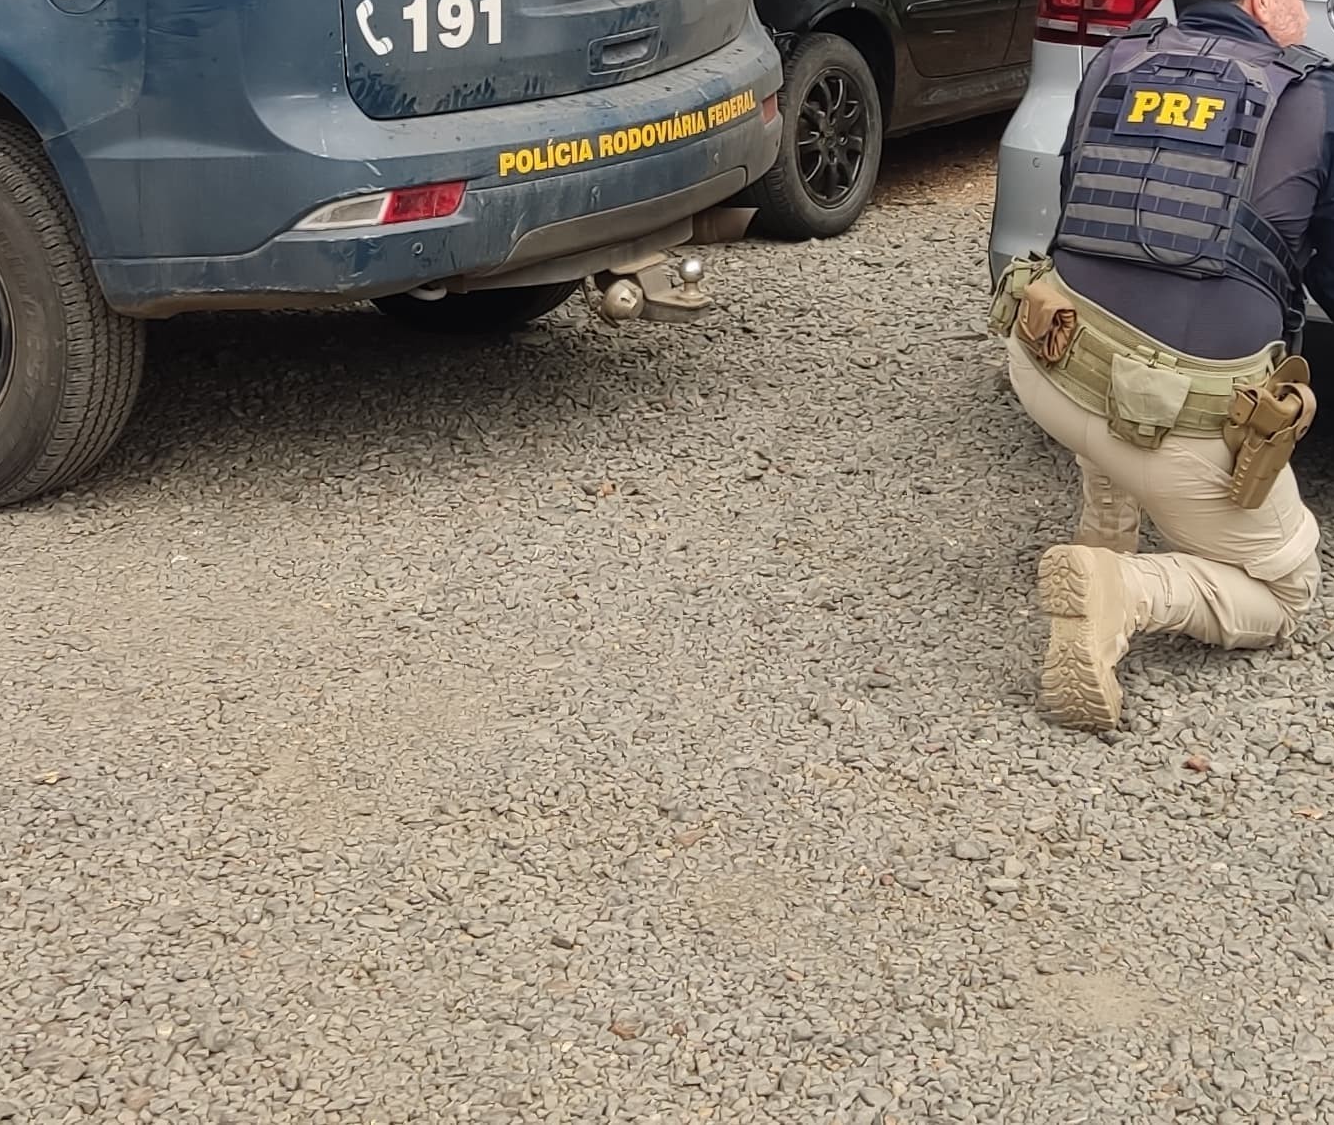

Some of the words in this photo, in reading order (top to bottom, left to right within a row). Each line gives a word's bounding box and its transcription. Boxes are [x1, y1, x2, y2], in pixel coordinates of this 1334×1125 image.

[499, 138, 594, 176] POLÍCIA
[599, 110, 706, 159] RODOVIÁRIA
[707, 89, 756, 129] FEDERAL
[1127, 89, 1226, 131] PRF
